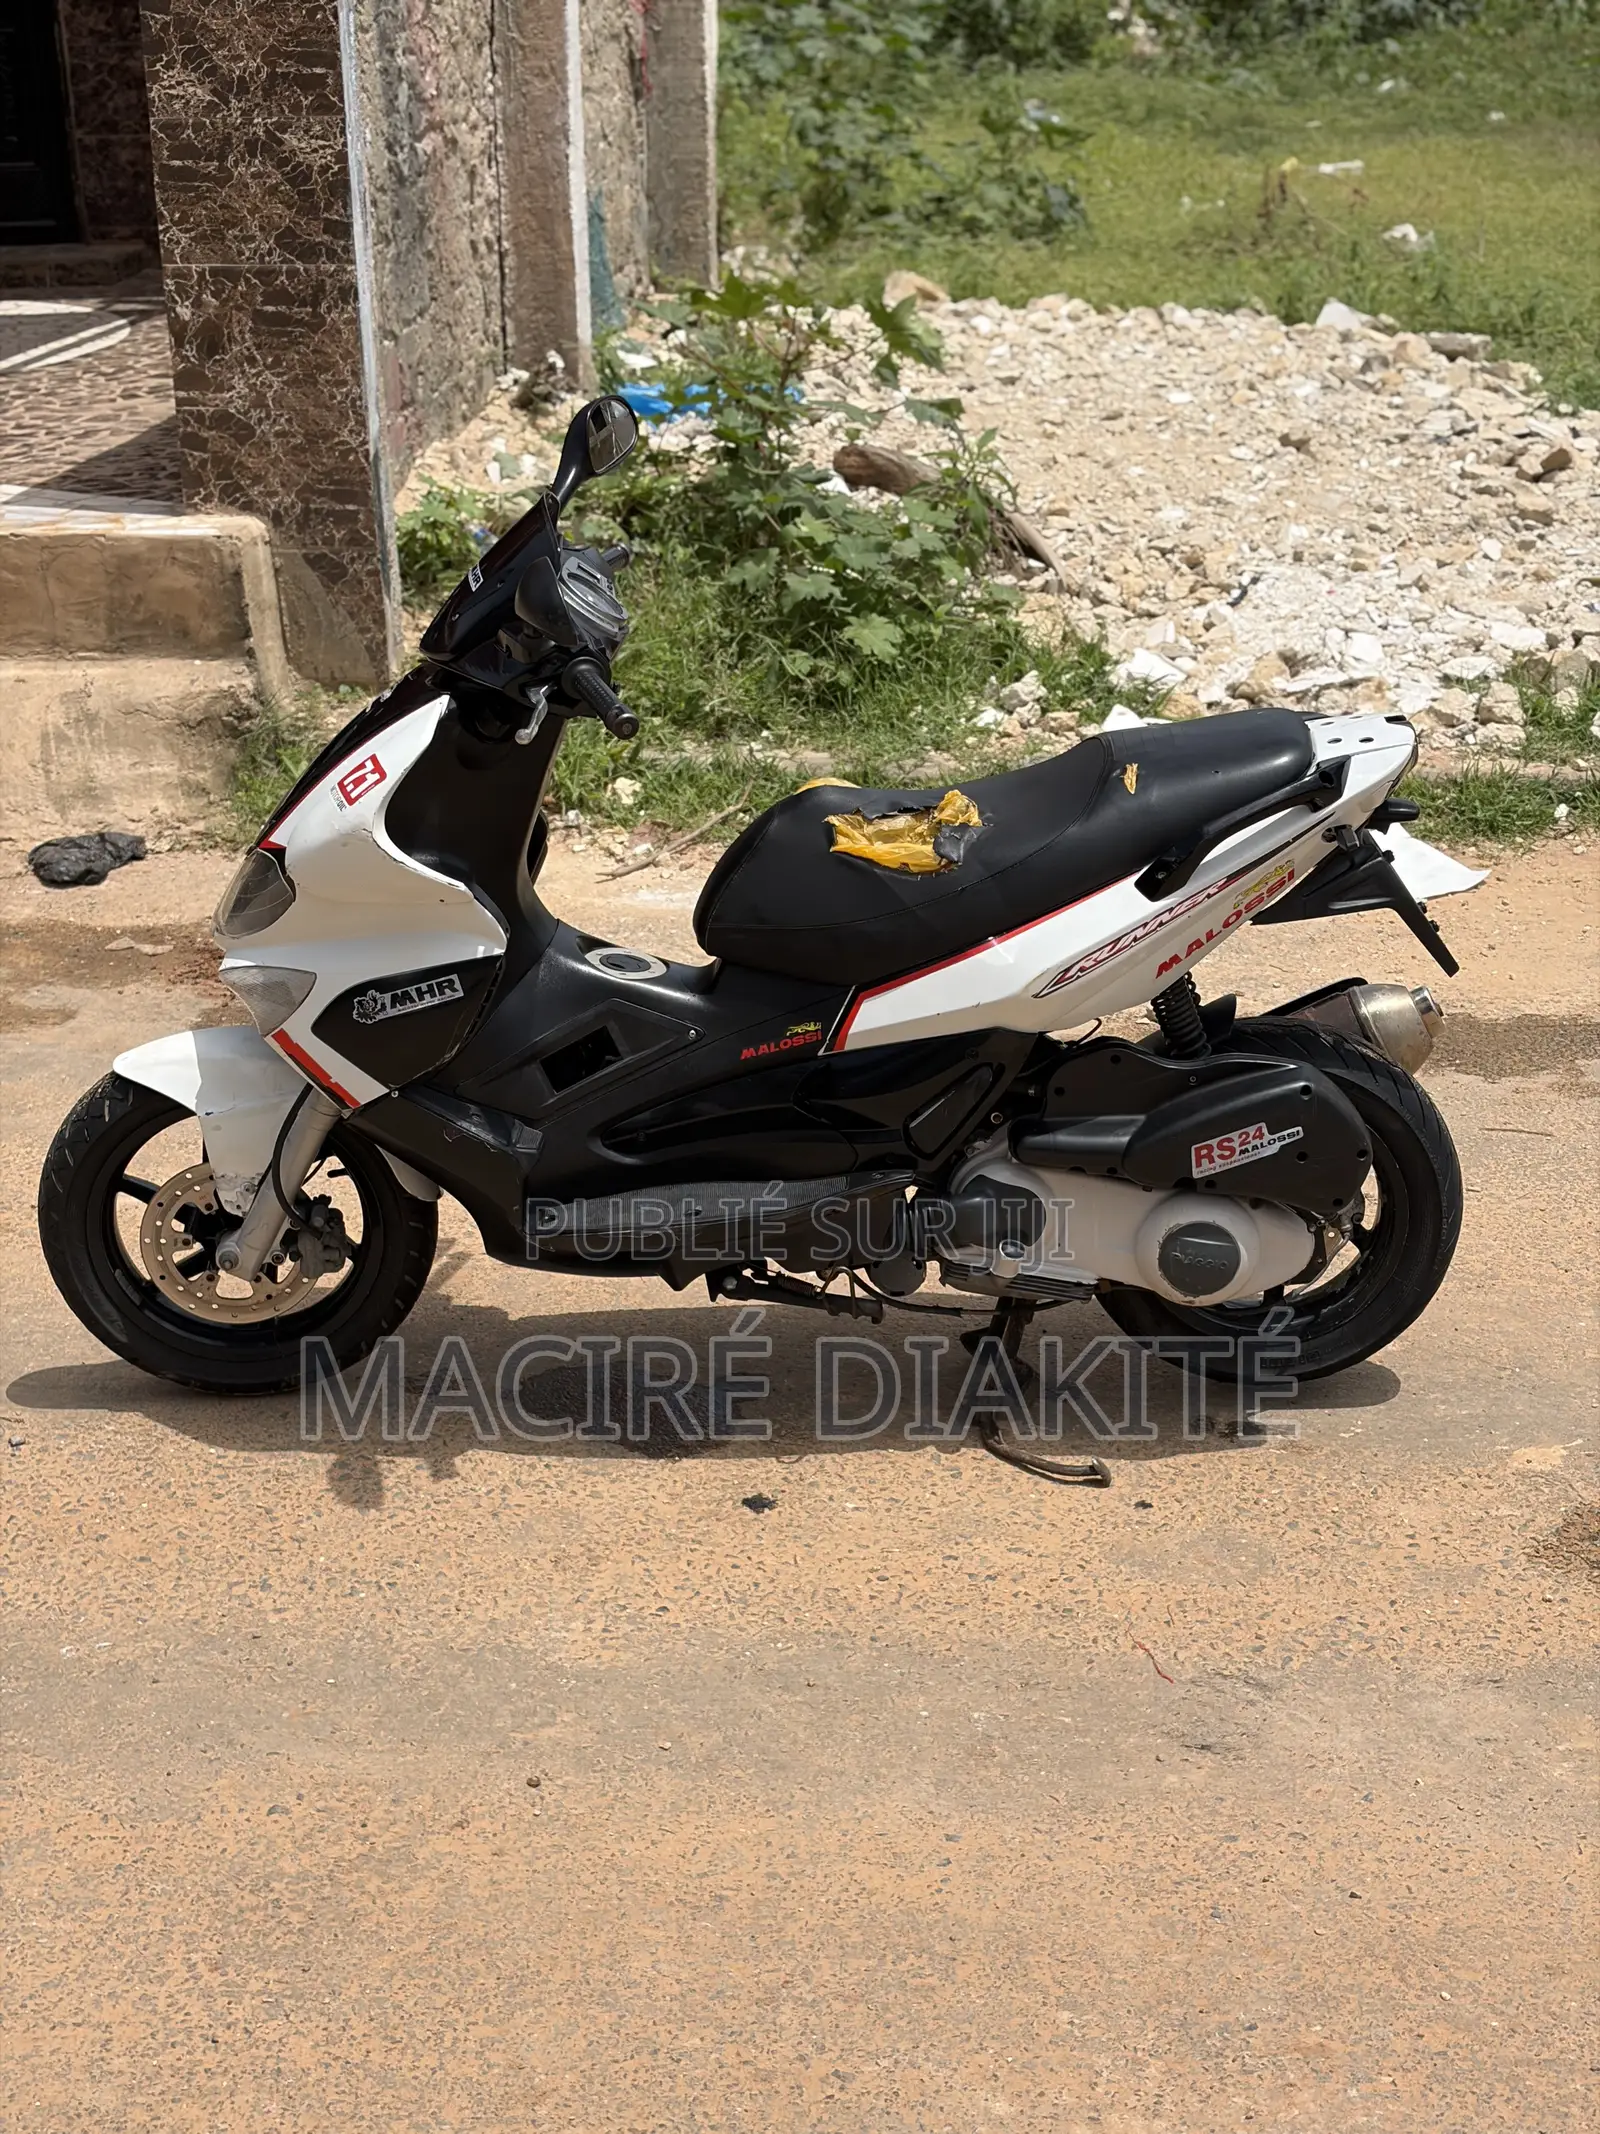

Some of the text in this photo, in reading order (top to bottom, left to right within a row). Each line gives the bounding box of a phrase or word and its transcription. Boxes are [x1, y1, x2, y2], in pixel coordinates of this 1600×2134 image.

[1053, 877, 1228, 985] RUNNER
[1156, 868, 1295, 980] MALOSSI
[390, 978, 459, 1010] MHR
[740, 1029, 823, 1061] MALOSSI
[1239, 1129, 1300, 1156] MALOSSI
